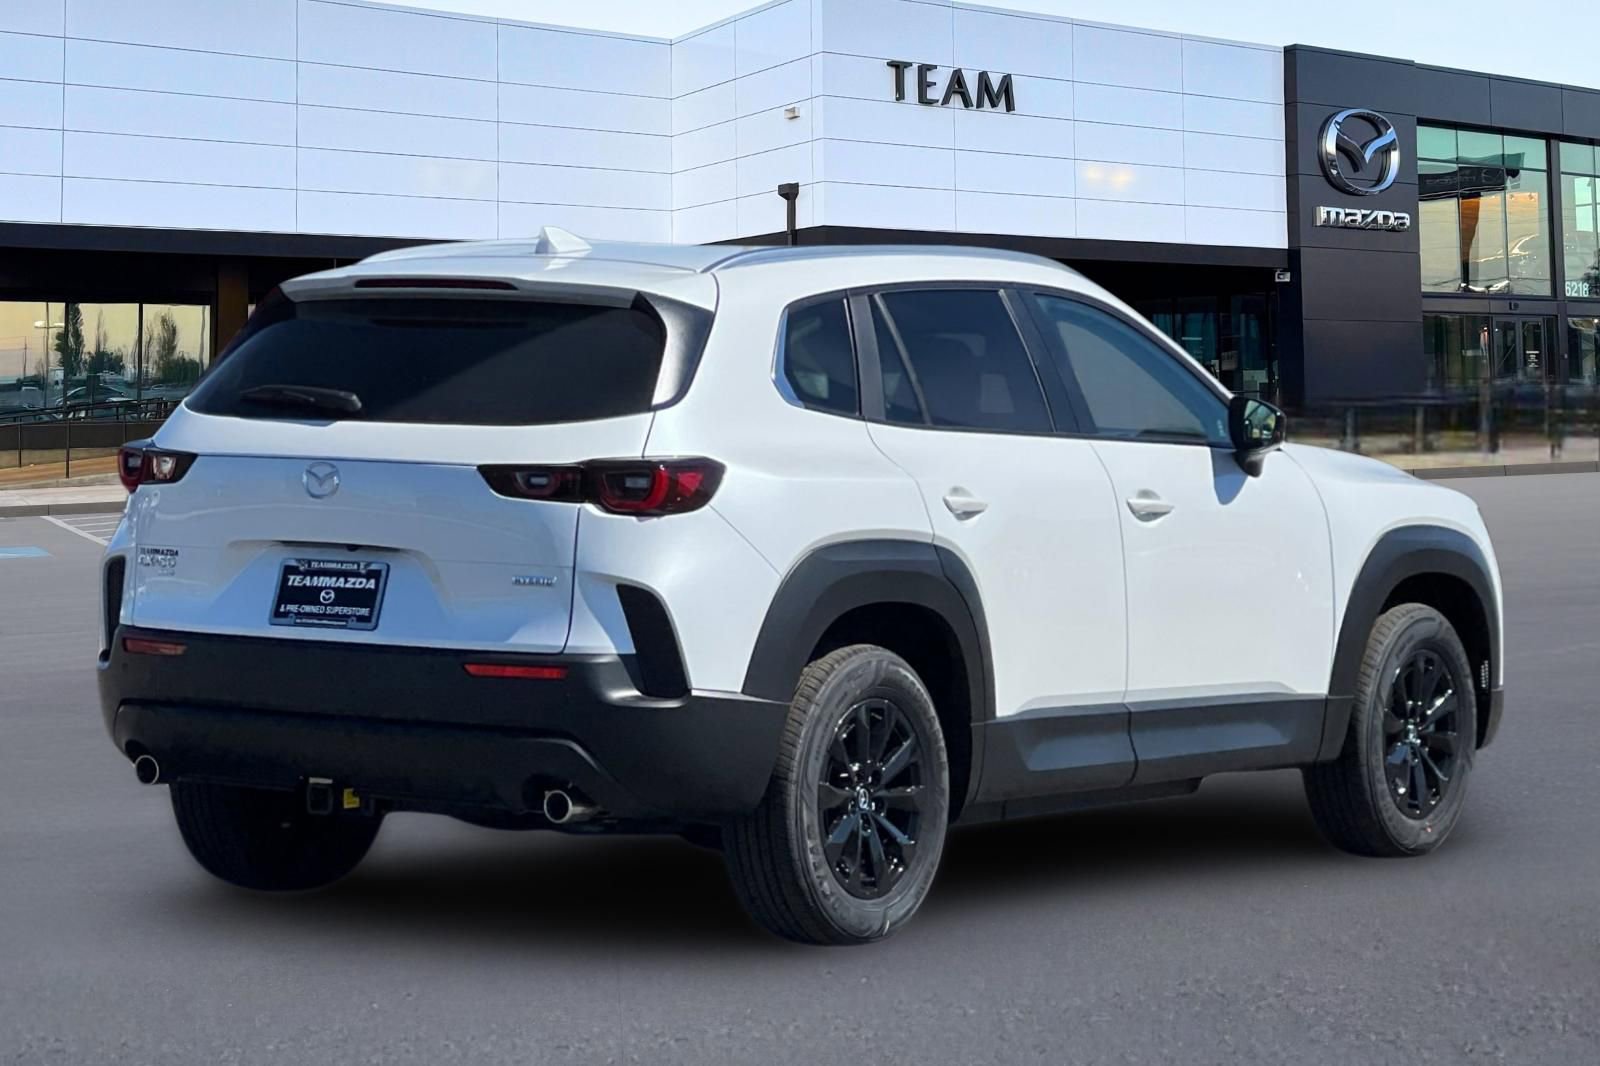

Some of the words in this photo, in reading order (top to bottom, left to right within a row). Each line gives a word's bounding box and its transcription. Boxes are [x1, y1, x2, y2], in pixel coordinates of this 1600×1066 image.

[886, 60, 1016, 112] TEAM
[1565, 281, 1590, 297] 6218
[287, 574, 376, 589] TEAMMAZDA
[286, 604, 325, 614] PRE-OWNED
[326, 605, 370, 616] SUPERSTORE
